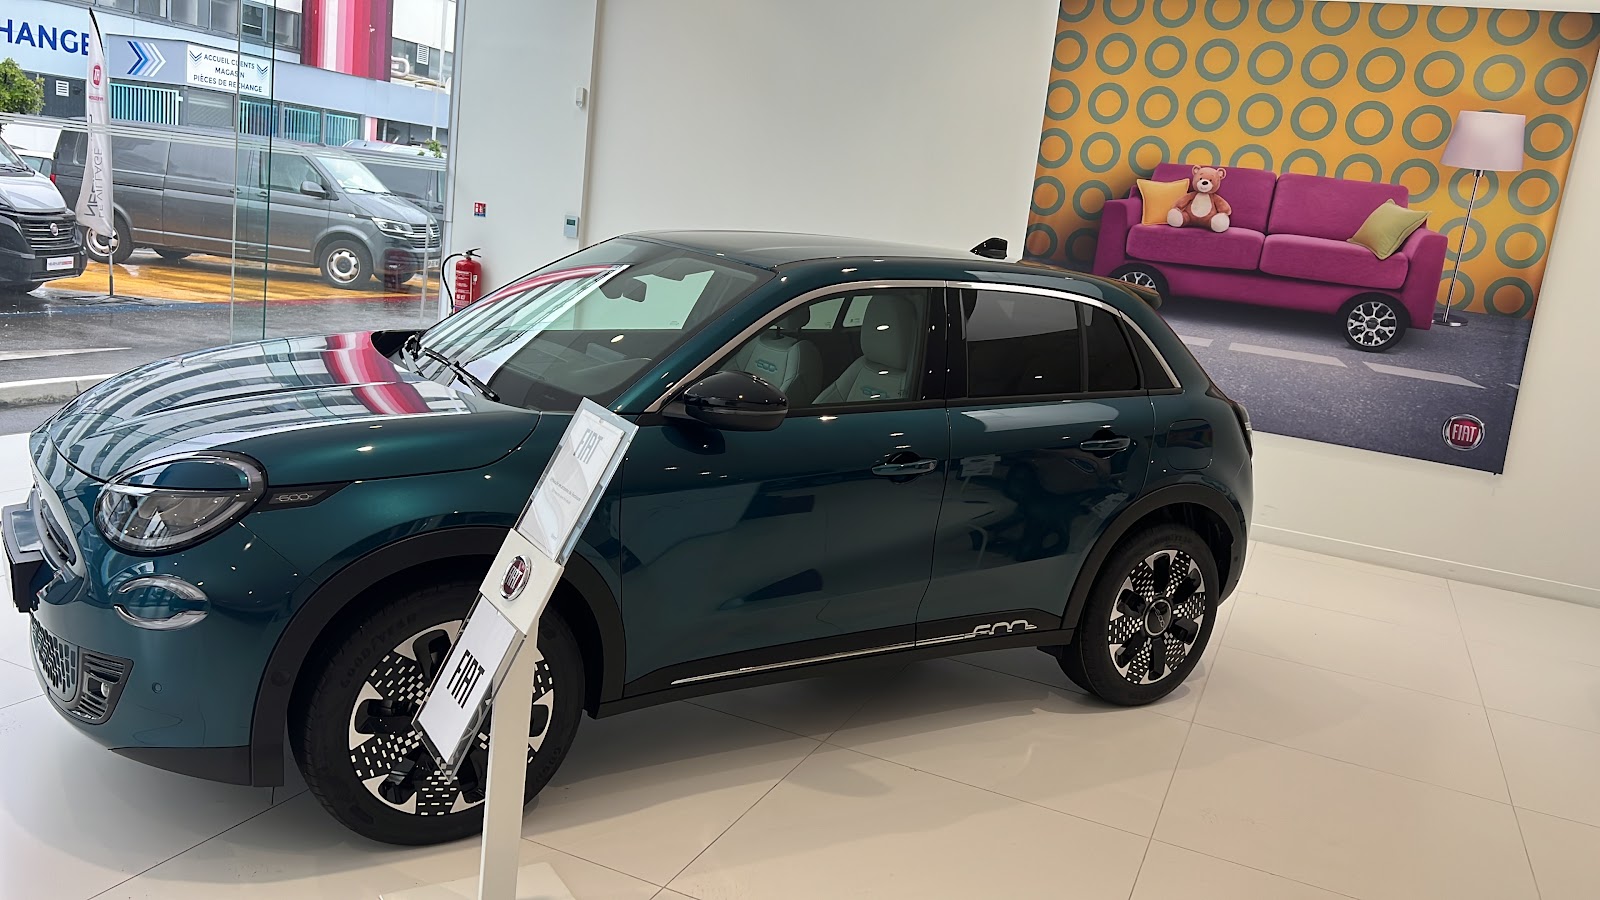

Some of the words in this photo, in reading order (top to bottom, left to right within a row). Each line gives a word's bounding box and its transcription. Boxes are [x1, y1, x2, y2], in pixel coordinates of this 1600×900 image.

[203, 54, 230, 65] ACCUEIL
[215, 67, 245, 78] MAGASN
[218, 79, 227, 87] DE
[1451, 423, 1477, 443] FIAT
[573, 428, 603, 464] FIAT
[504, 564, 524, 590] FIAT
[446, 648, 486, 709] FIAT
